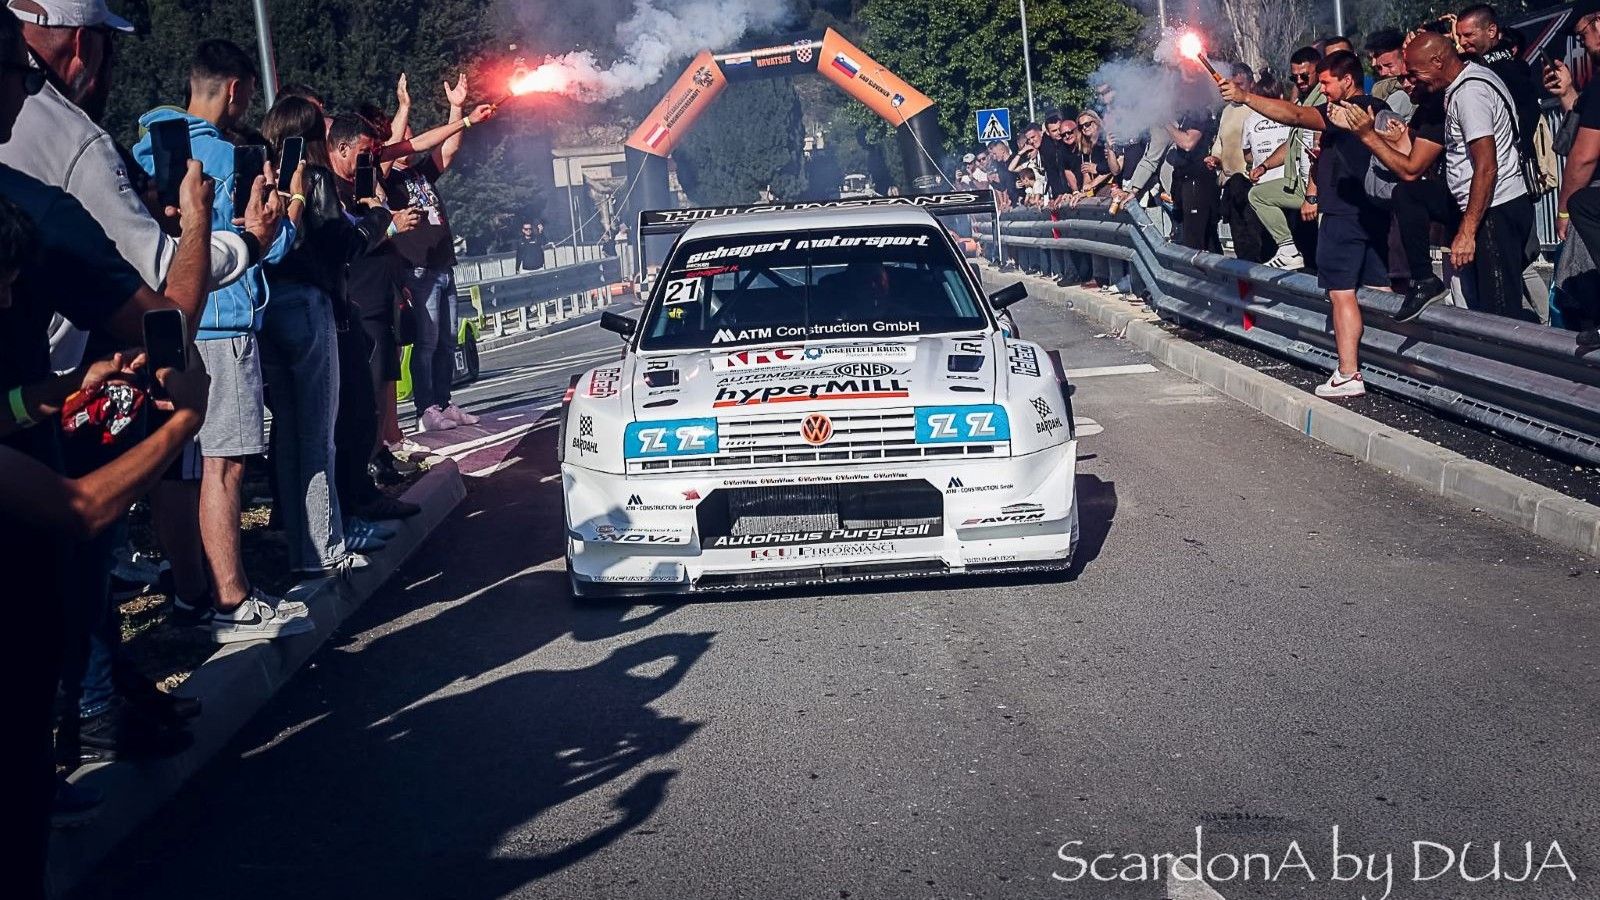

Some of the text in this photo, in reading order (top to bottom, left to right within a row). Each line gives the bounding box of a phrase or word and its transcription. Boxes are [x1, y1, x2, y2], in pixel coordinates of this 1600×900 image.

[796, 234, 930, 250] motorsport
[665, 280, 698, 303] 21
[737, 321, 921, 341] ATM Construction GmbH
[718, 369, 833, 384] AUTOMOBILE
[843, 363, 888, 376] OFNER
[713, 379, 909, 405] hyperMILL
[1036, 417, 1063, 434] BARDAHL
[572, 437, 599, 454] BARDAHL
[980, 513, 1045, 524] AVON
[714, 524, 931, 547] Autohaus Purgstall
